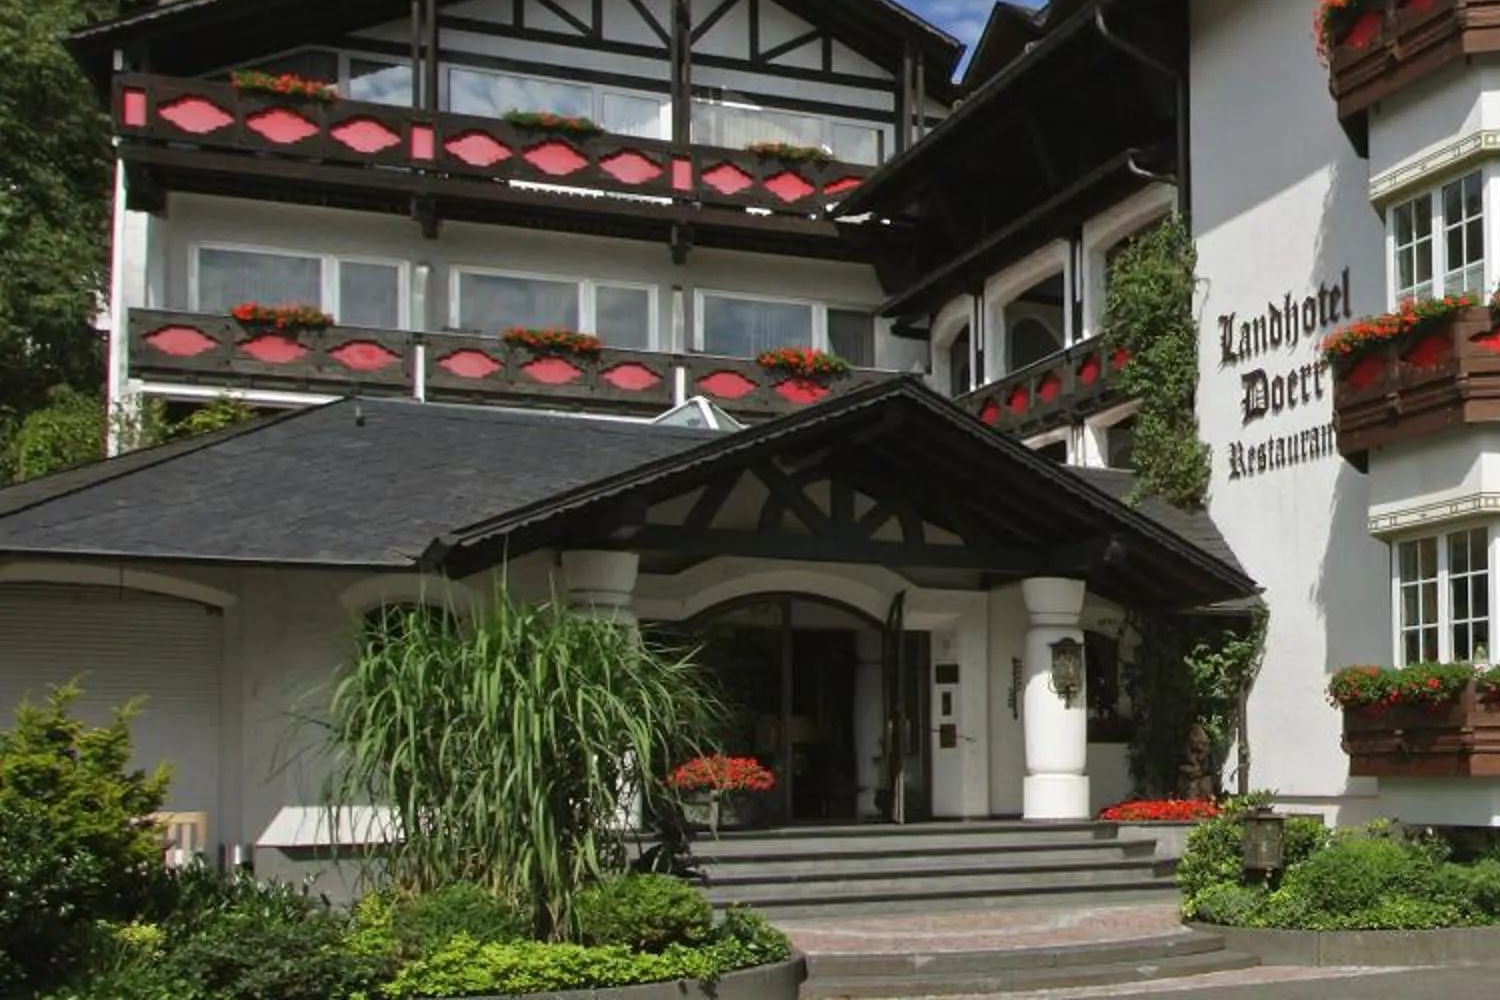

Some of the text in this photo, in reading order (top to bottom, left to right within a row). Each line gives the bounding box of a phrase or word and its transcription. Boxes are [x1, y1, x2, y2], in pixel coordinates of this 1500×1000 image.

[1217, 265, 1351, 373] Landhotel
[1240, 360, 1329, 427] Doerr
[1228, 423, 1335, 481] Restauran
